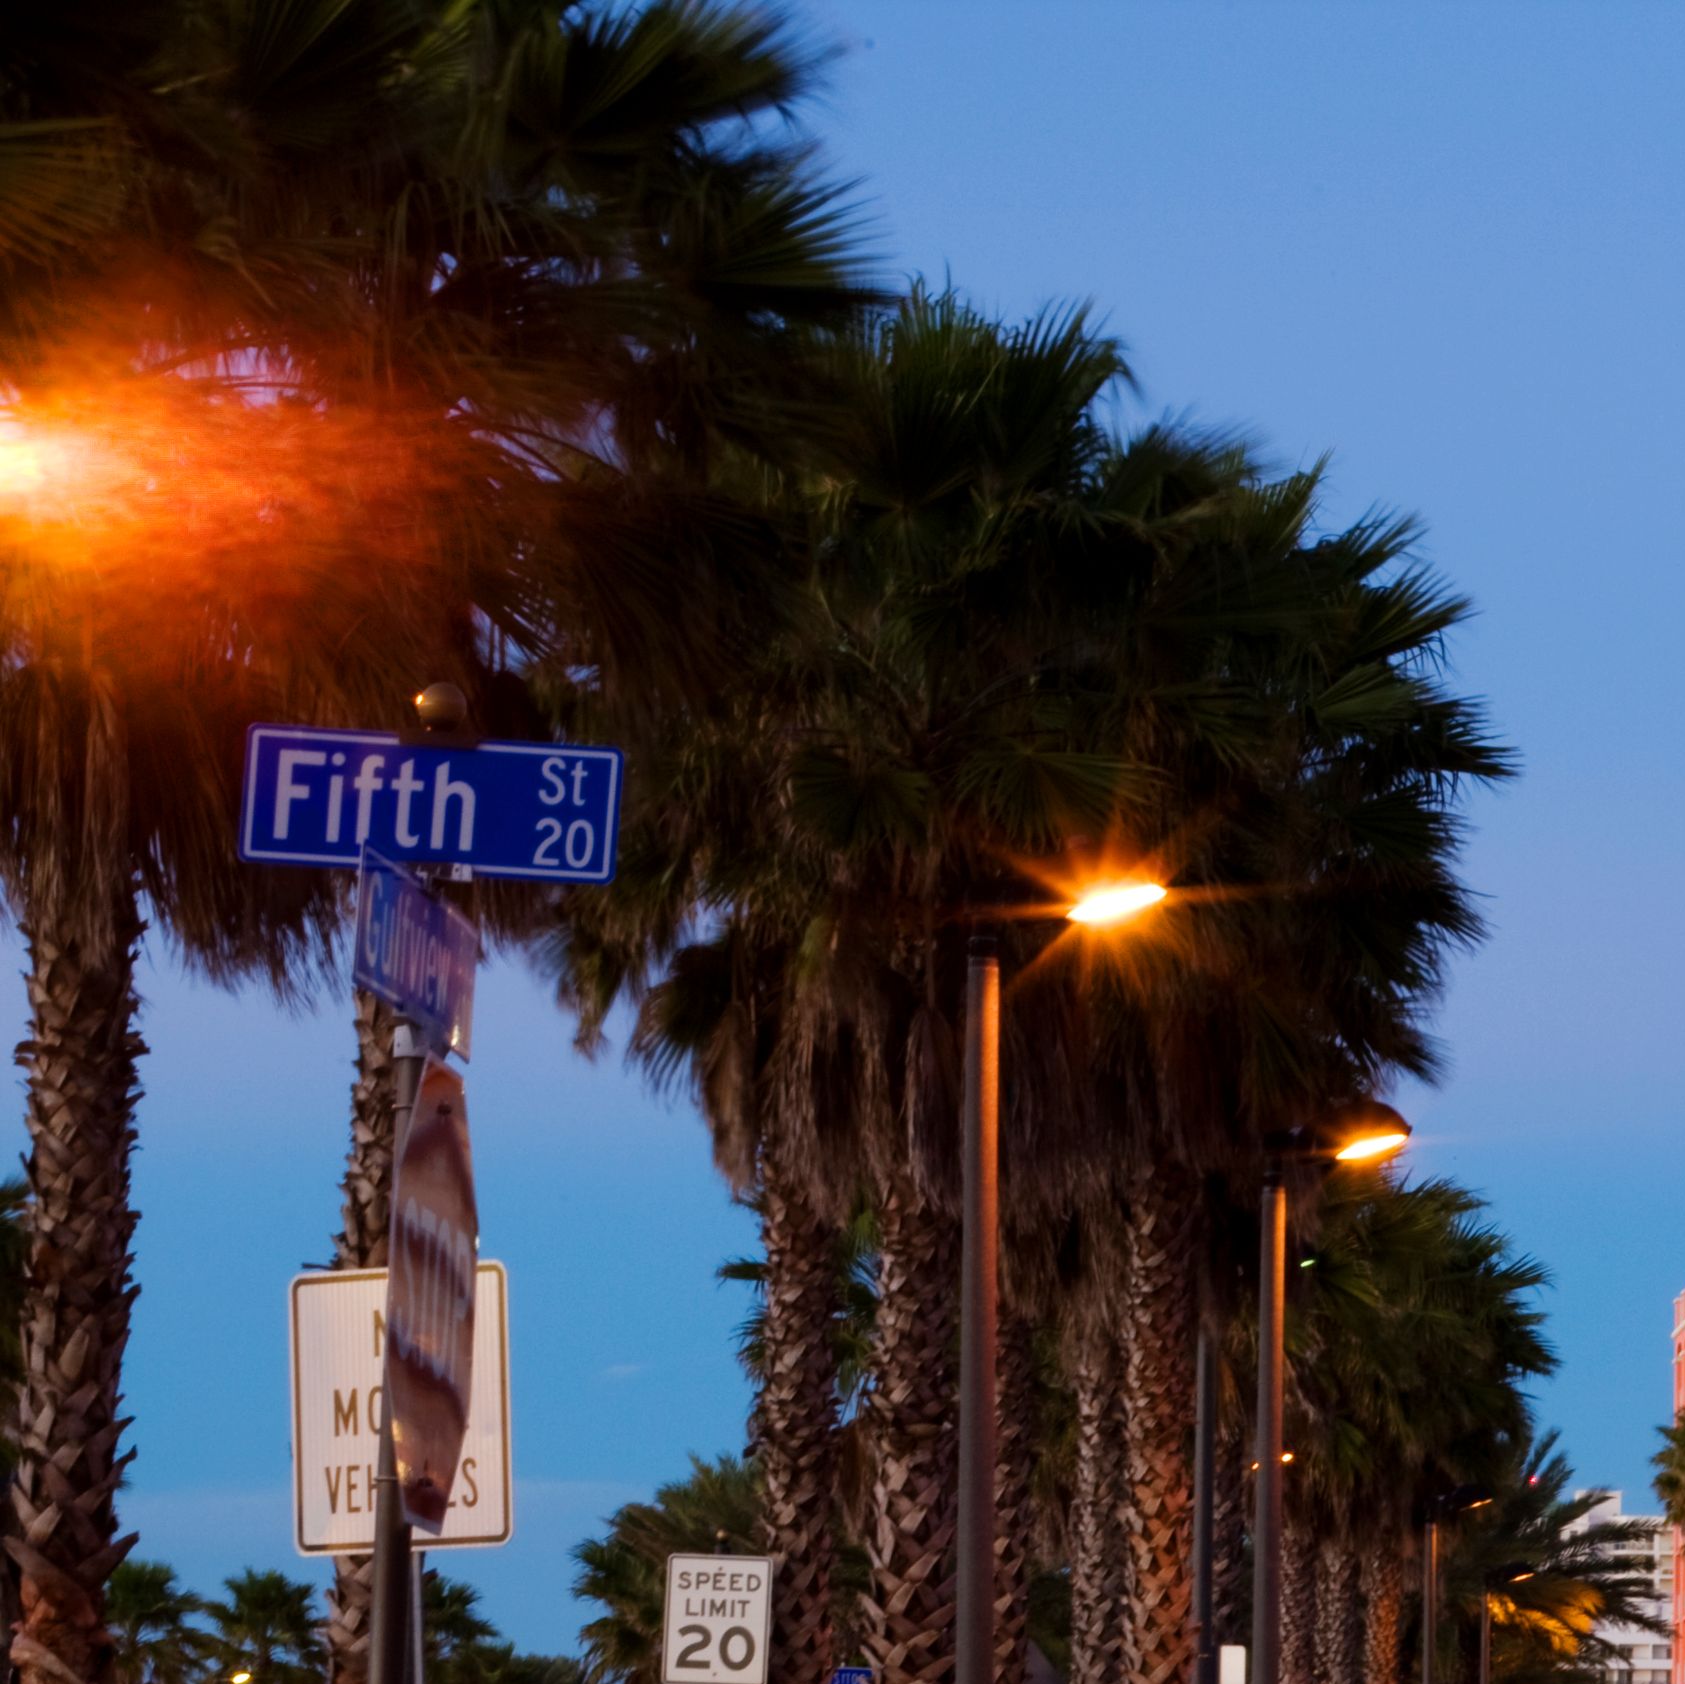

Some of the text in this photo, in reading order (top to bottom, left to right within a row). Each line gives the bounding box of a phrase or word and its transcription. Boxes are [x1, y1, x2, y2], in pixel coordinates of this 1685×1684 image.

[273, 749, 588, 852] Fifth St
[532, 817, 595, 869] 20
[364, 871, 451, 1013] Gulfview
[678, 1571, 762, 1593] SPEED
[684, 1598, 750, 1619] LIMIT
[675, 1624, 756, 1671] 20
